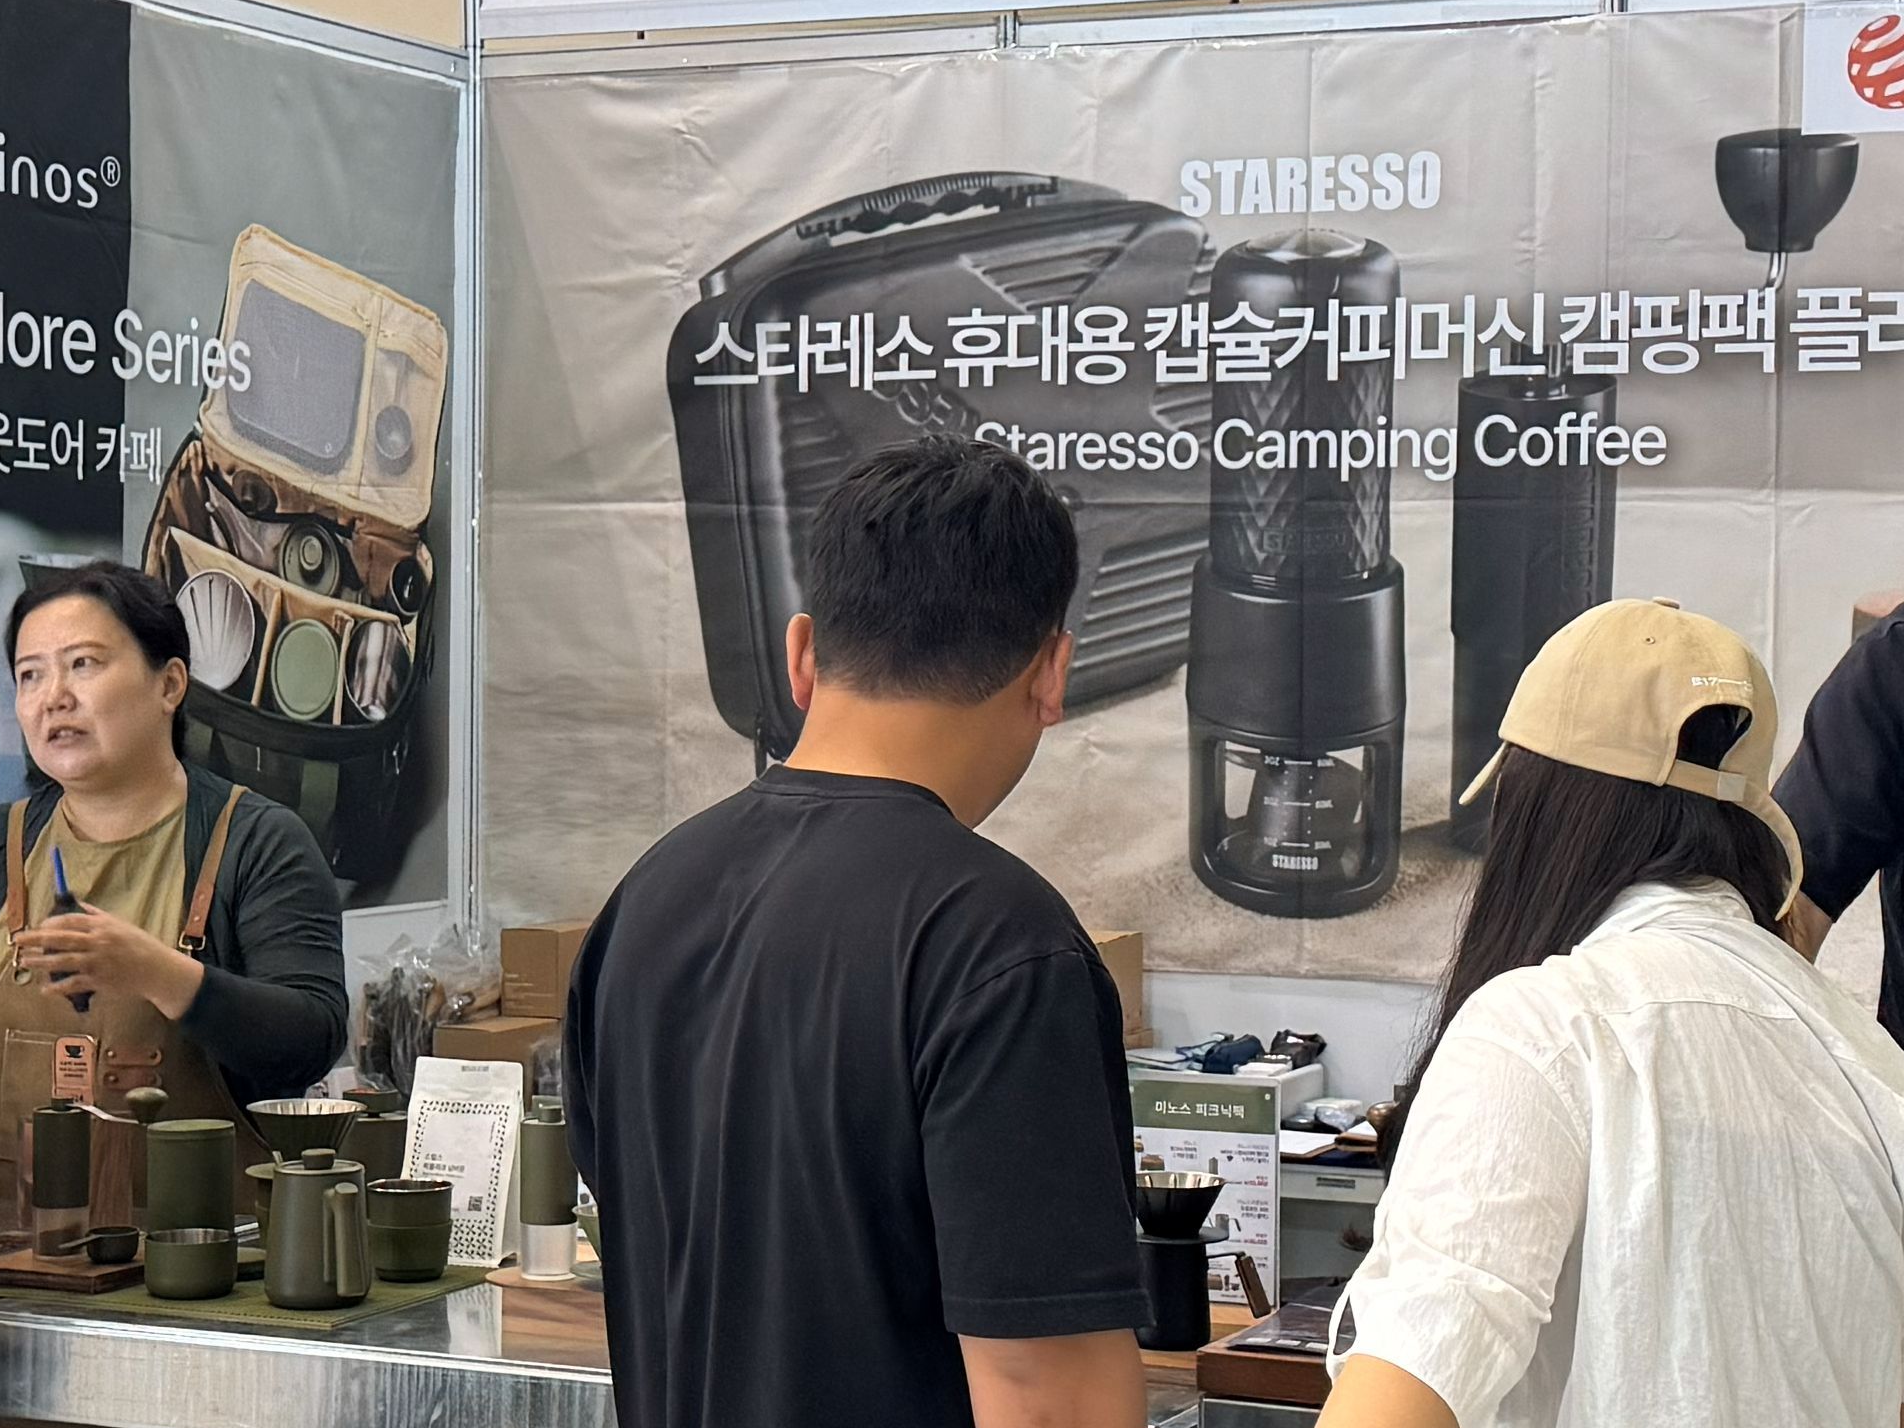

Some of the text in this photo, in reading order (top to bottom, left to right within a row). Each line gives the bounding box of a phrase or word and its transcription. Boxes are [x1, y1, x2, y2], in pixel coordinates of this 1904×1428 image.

[1179, 150, 1442, 218] STARESSO
[111, 307, 252, 393] Series
[693, 311, 938, 394] 스타레소
[943, 304, 1138, 389] 휴대용
[1142, 291, 1547, 382] 캡슐커피머신
[1559, 286, 1777, 376] 캠핑팩
[95, 422, 164, 486] 카페
[974, 411, 1668, 483] Staresso Camping Coffee
[1155, 1100, 1192, 1116] 미노스
